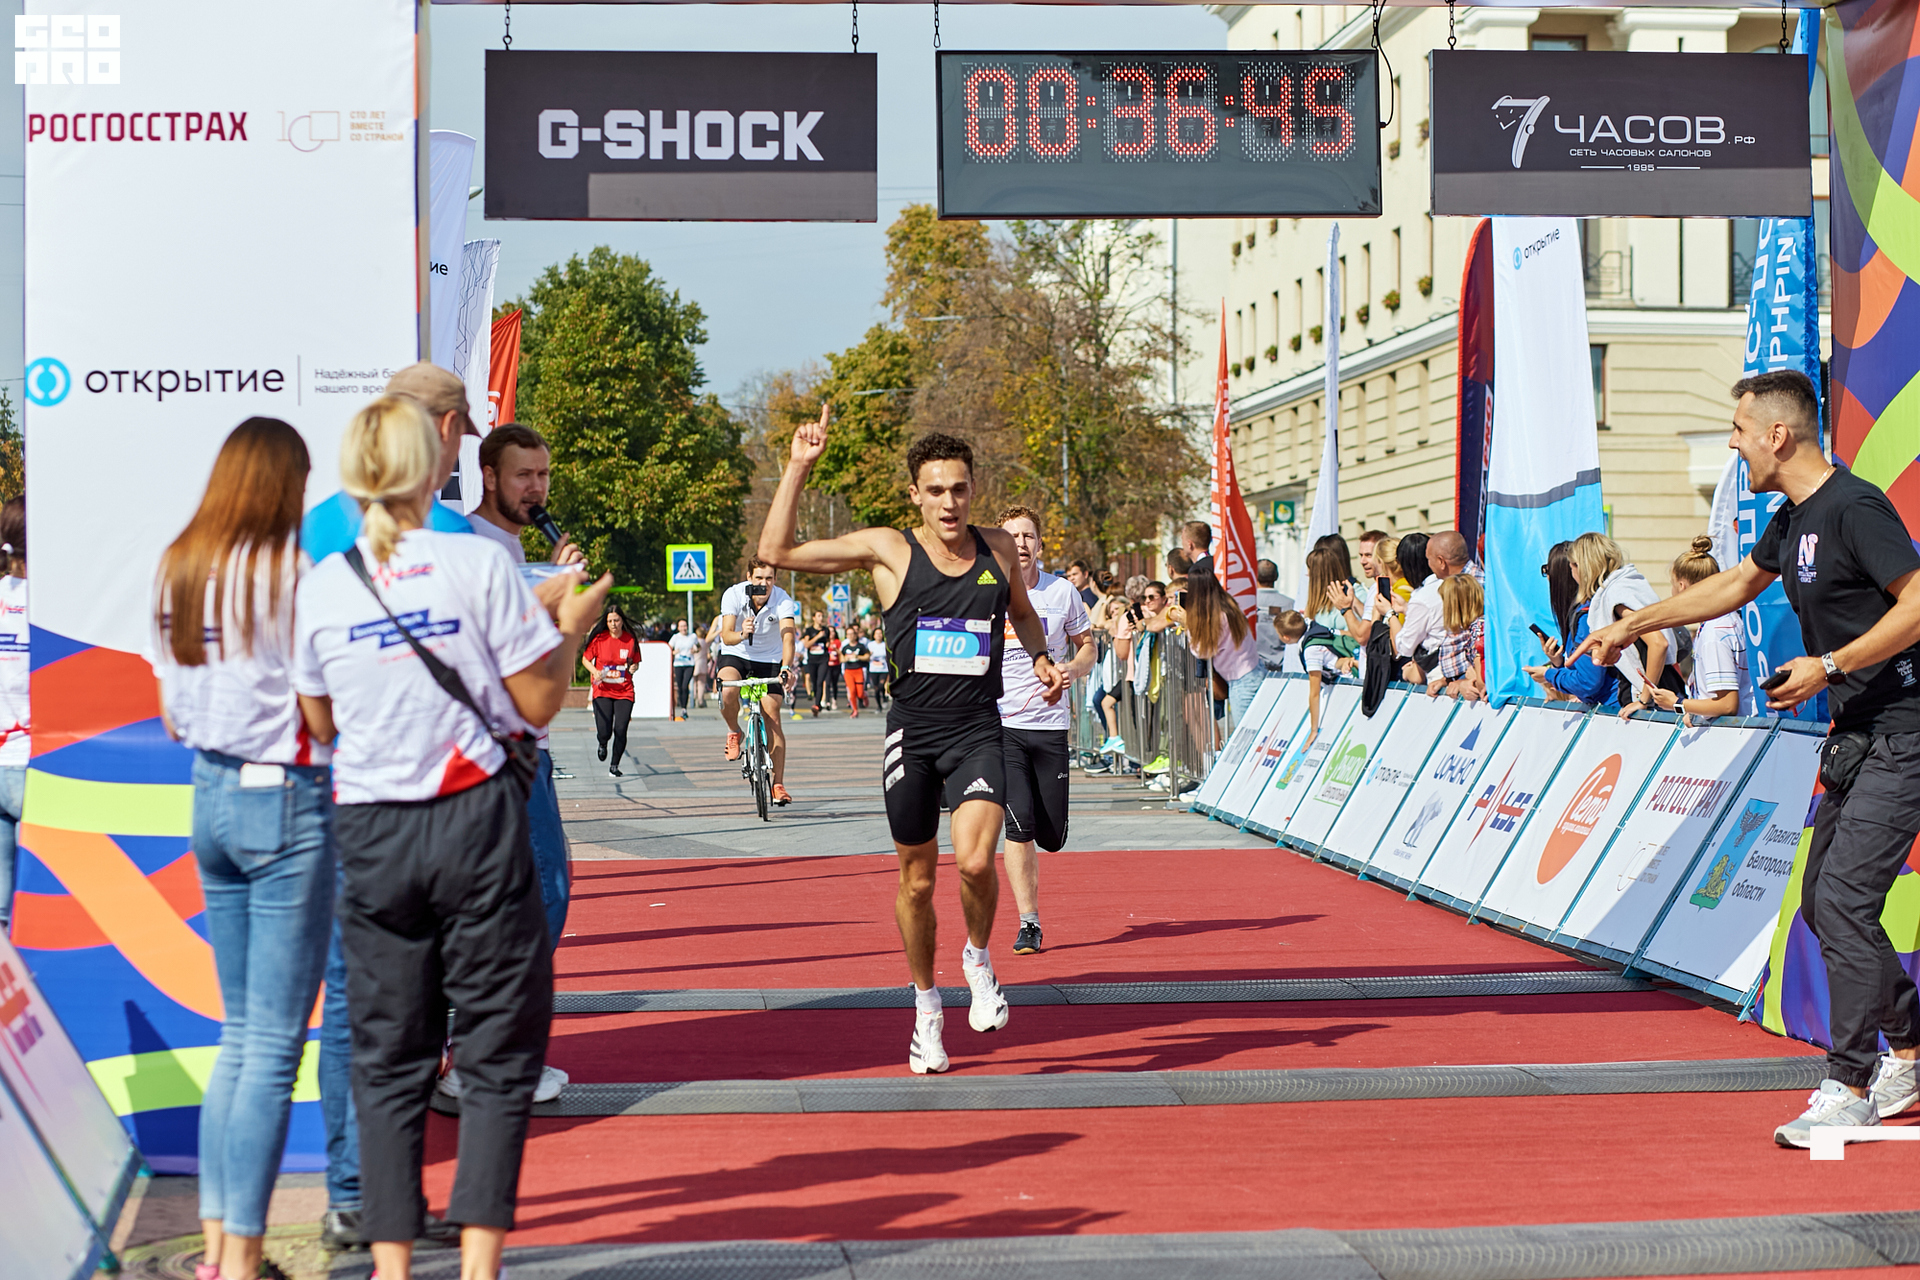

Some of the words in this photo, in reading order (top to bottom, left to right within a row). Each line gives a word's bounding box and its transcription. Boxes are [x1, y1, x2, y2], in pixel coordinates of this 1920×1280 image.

[350, 111, 367, 119] СТО
[369, 111, 386, 119] ЛЕТ
[966, 68, 1353, 156] 00:36:45
[28, 112, 249, 142] РОСГОССТРАХ
[350, 122, 384, 130] ВМЕСТЕ
[350, 133, 362, 141] СО
[364, 132, 404, 141] СТРАНОЙ
[538, 109, 825, 161] G-SHOCK
[1569, 149, 1597, 157] СЕТЬ
[1600, 149, 1655, 157] ЧАСОВЫХ
[1658, 149, 1712, 158] САЛОНОВ
[1627, 164, 1655, 172] 1995
[1523, 228, 1560, 259] открытие
[85, 368, 285, 402] открытие
[314, 368, 379, 380] Надёжный
[314, 385, 359, 393] нашего
[362, 385, 385, 396] вре
[927, 634, 967, 656] 1110
[1645, 775, 1732, 818] РОСГОССТРАХ
[1731, 879, 1767, 902] области
